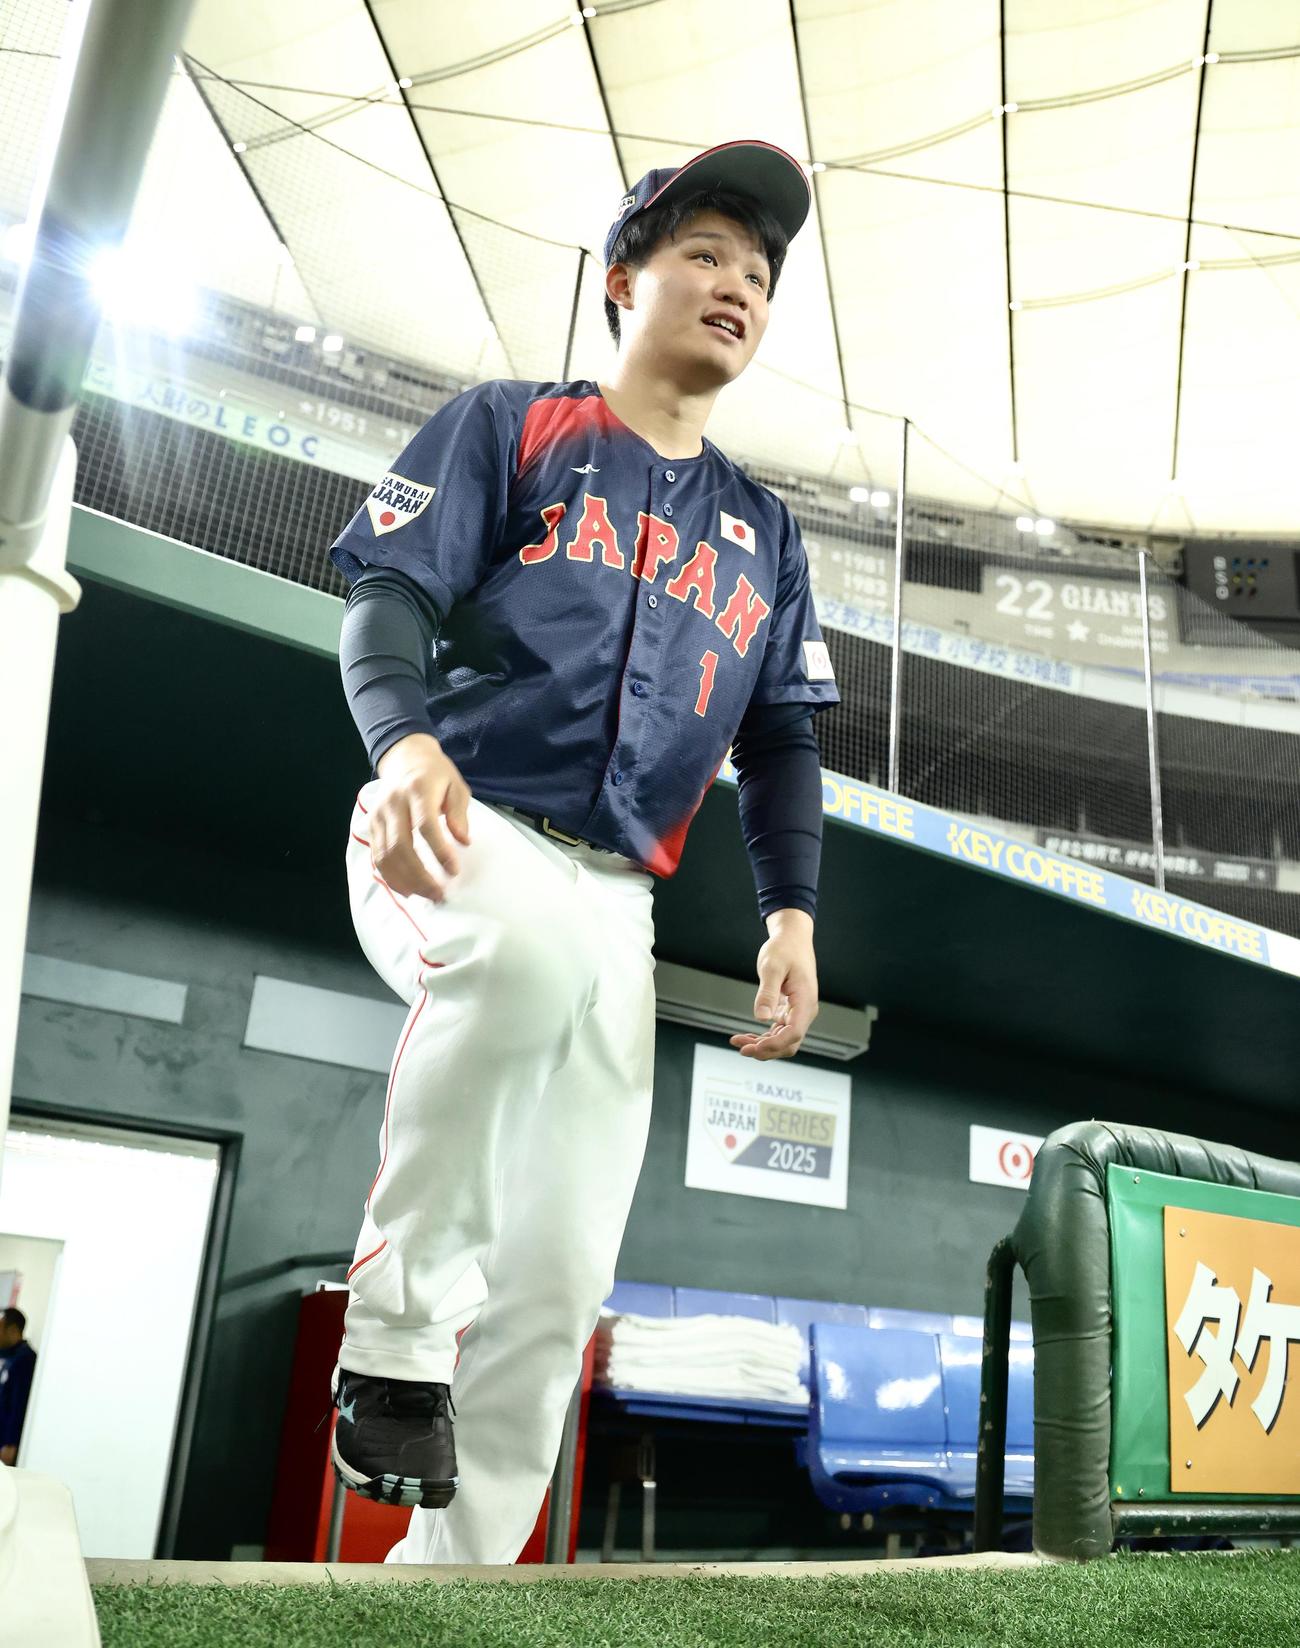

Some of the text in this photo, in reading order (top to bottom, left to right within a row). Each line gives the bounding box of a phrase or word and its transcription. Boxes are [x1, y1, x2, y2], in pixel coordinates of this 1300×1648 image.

[372, 486, 424, 514] JAPAN
[381, 476, 430, 501] SAMURAI
[519, 492, 771, 658] JAPAN
[995, 574, 1168, 622] 22 GIANTS
[694, 650, 719, 718] 1
[822, 778, 915, 839] OFFEE
[756, 1083, 803, 1101] RAXUS
[708, 1107, 832, 1141] JAPAN SERIES
[767, 1141, 817, 1174] 2025
